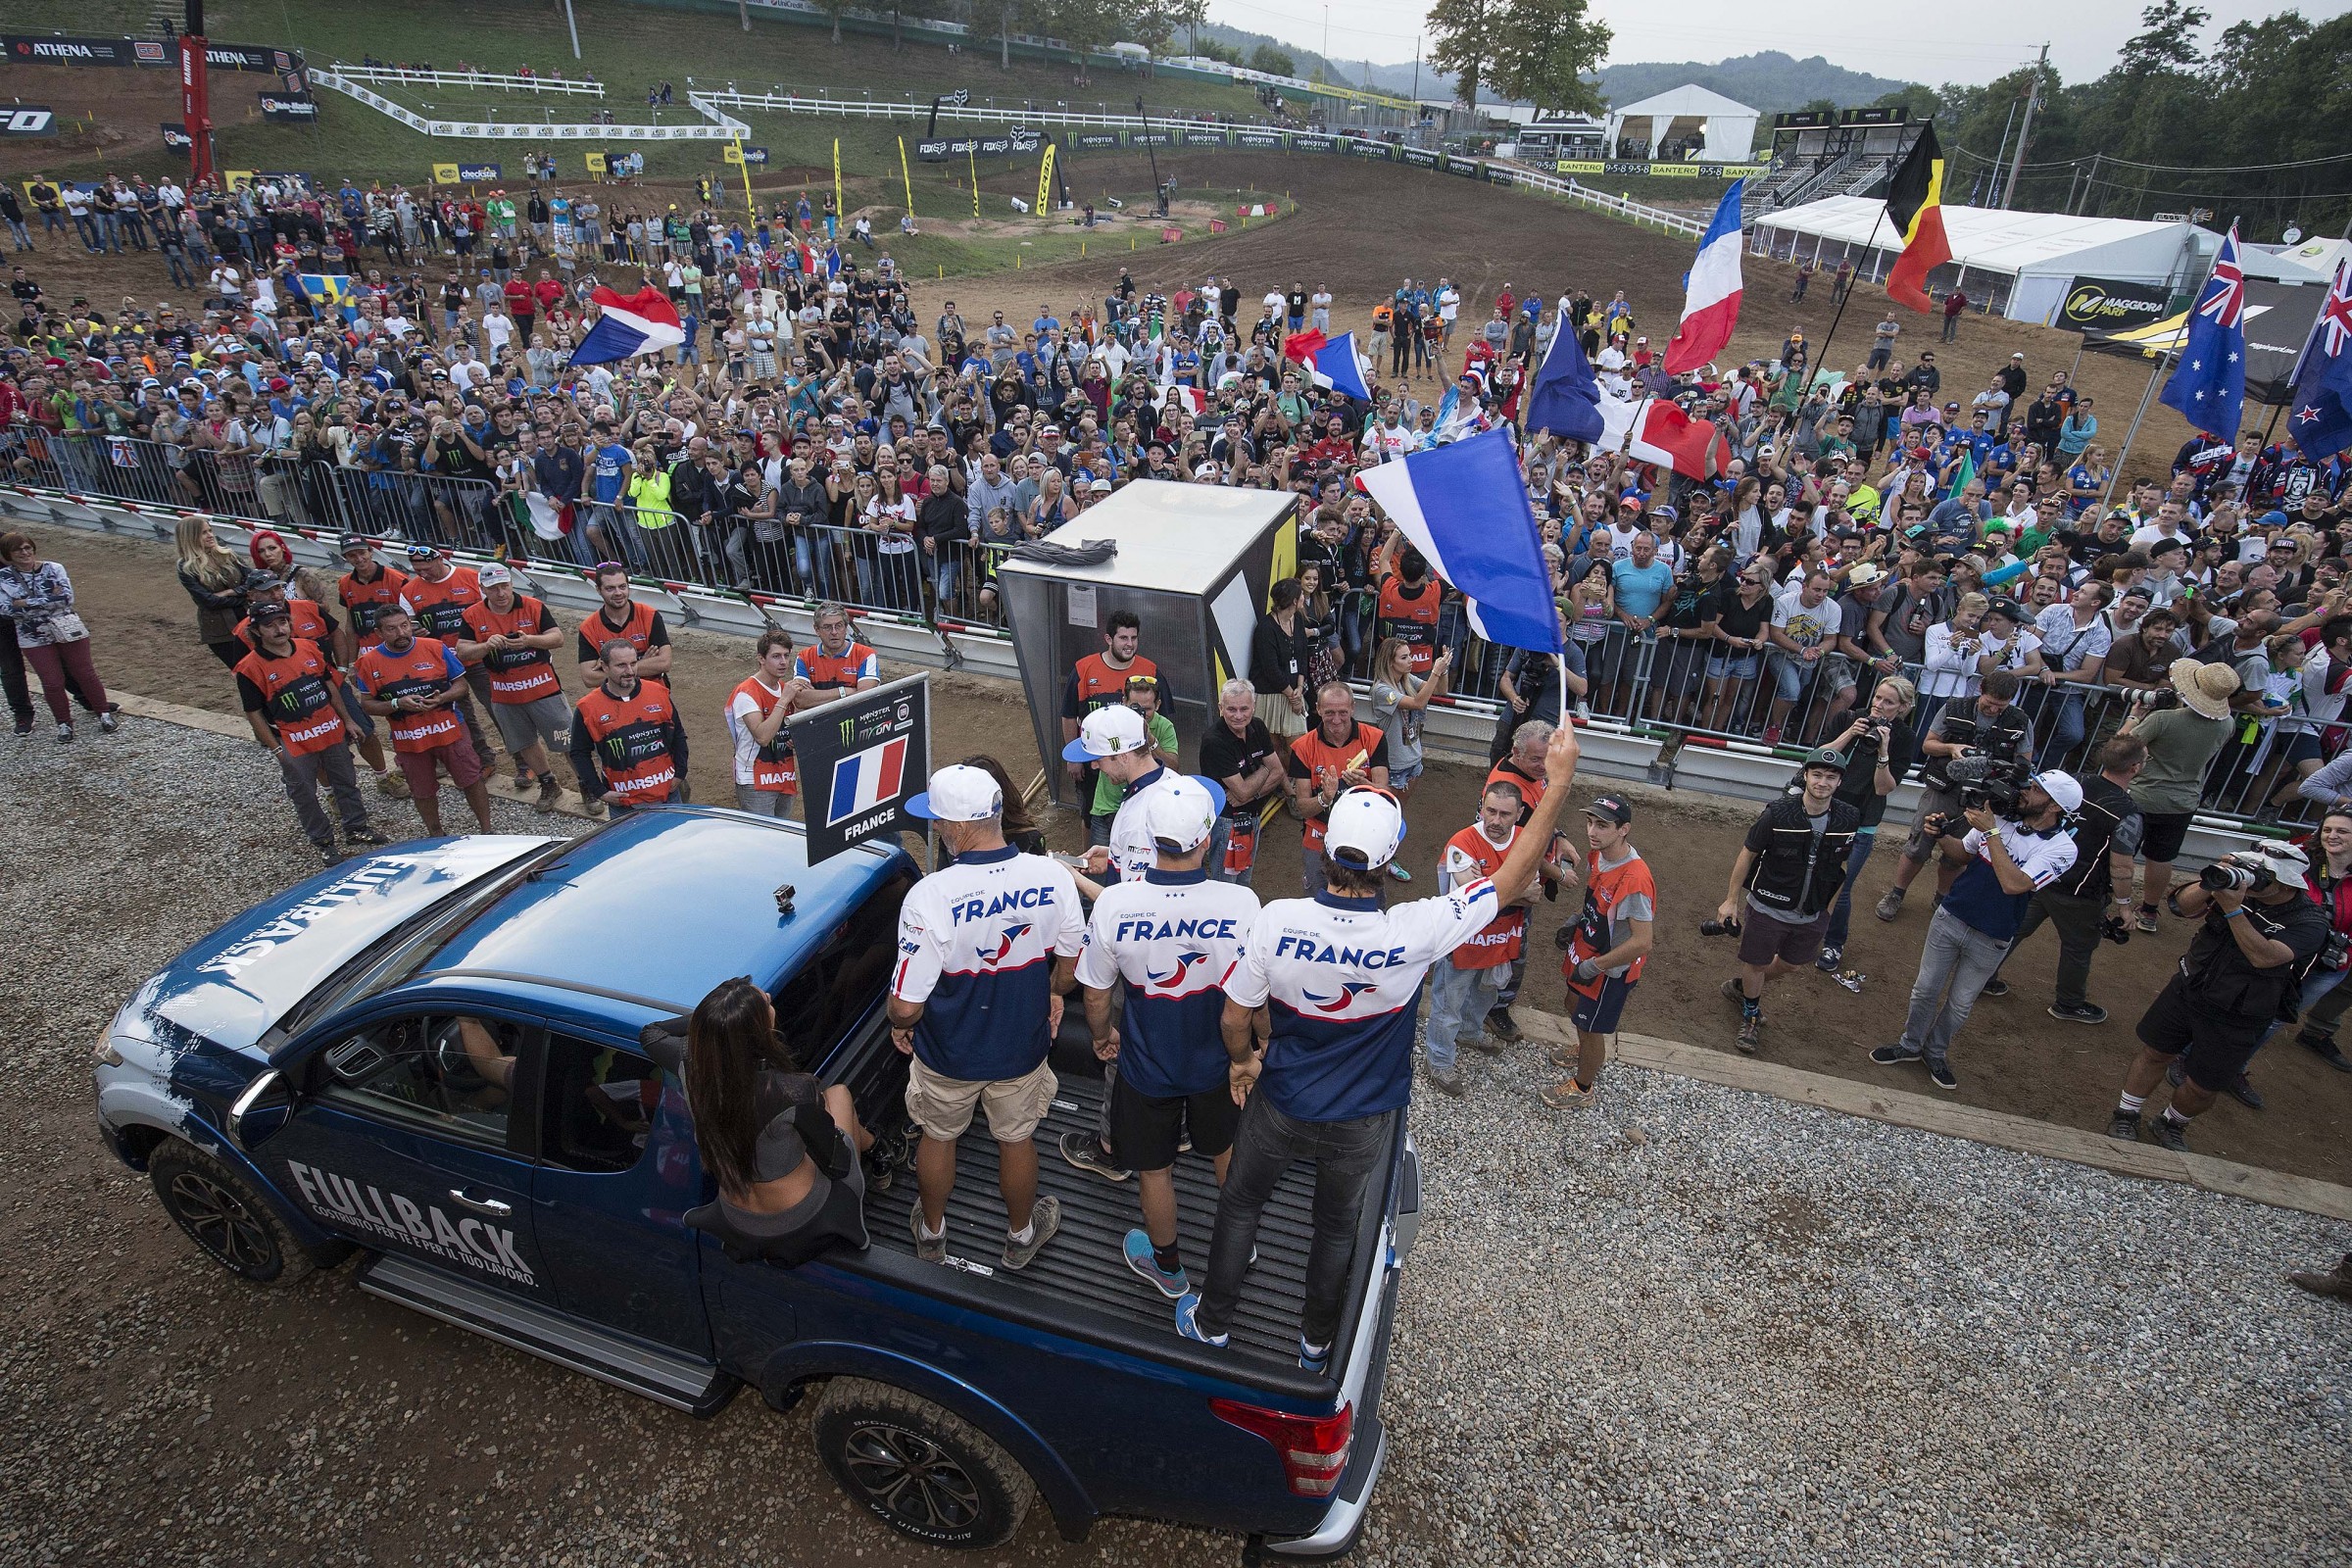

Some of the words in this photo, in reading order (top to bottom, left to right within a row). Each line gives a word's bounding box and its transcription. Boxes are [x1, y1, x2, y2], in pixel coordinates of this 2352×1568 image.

[33, 43, 93, 58] ATHENA
[1188, 134, 1220, 143] MONSTER
[1242, 135, 1274, 144] MONSTER
[1298, 138, 1330, 148] MONSTER
[1353, 144, 1386, 155] MONSTER
[1405, 152, 1434, 164] MONSTER
[462, 170, 498, 178] checkstar
[1449, 162, 1474, 172] MONSTER
[1559, 163, 1602, 172] SANTERO
[1652, 167, 1696, 175] SANTERO
[1488, 170, 1513, 180] MONSTER
[1039, 153, 1052, 215] ACERBIS
[2097, 305, 2128, 318] PARK
[2104, 298, 2164, 314] MAGGIORA
[436, 607, 466, 617] MONSTER
[437, 618, 464, 630] MXO
[299, 679, 321, 693] MONSTE
[493, 672, 553, 692] MARSHALL
[396, 684, 432, 696] MONSTER
[859, 706, 892, 722] MONSTER
[394, 719, 457, 741] MARSHALL
[628, 727, 662, 741] MONSTER
[845, 808, 895, 842] FRANCE
[951, 893, 973, 905] EQUIPE
[952, 886, 1055, 927] FRANCE
[198, 854, 419, 978] FULLBACK
[1115, 919, 1237, 942] FRANCE
[1283, 927, 1308, 936] EQUIPE
[195, 942, 242, 972] LAVORO
[1275, 936, 1406, 969] FRANCE
[287, 1159, 534, 1275] FULLBACK
[313, 1204, 373, 1232] COSTRUITO
[375, 1223, 397, 1241] PER
[399, 1232, 413, 1245] TE
[423, 1240, 445, 1256] PER
[447, 1248, 458, 1260] IL
[459, 1251, 484, 1269] TUO
[870, 1503, 891, 1521] T/A
[898, 1520, 971, 1541] All-Terrain
